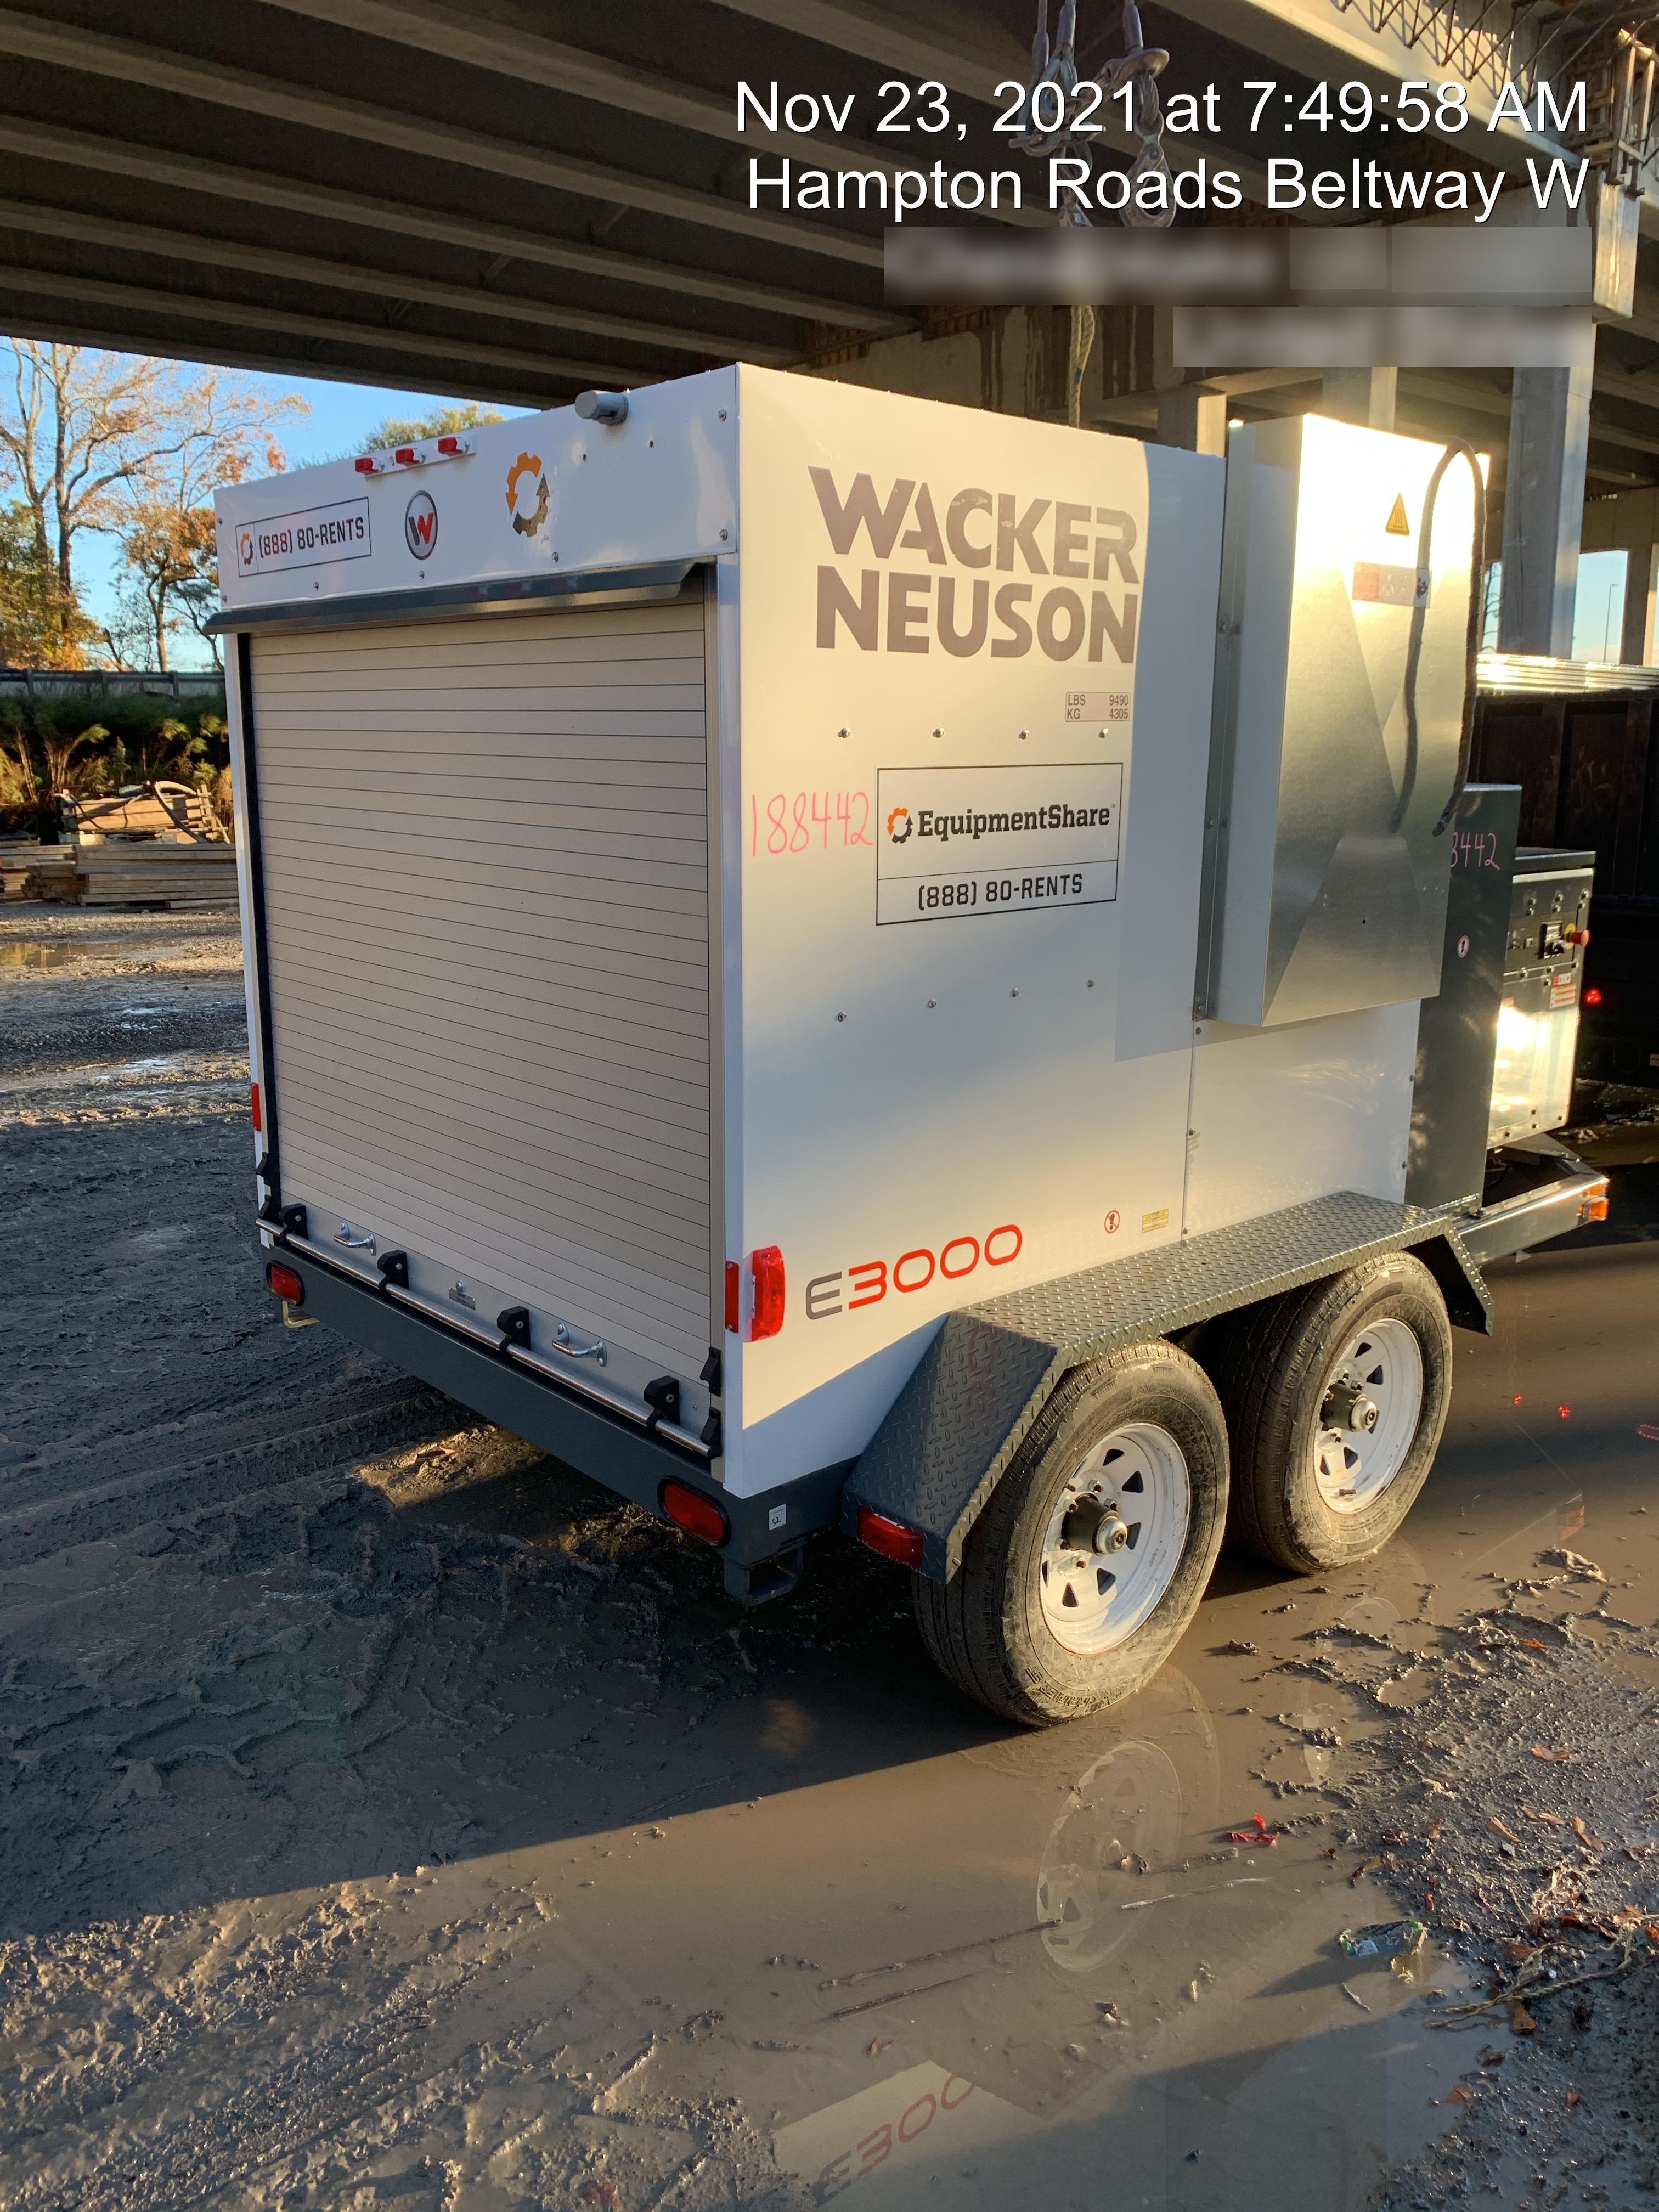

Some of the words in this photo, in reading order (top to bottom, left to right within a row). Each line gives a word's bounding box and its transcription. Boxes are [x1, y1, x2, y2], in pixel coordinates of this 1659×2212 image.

[259, 529, 293, 558] (888)
[297, 516, 364, 549] 80-RENTS
[808, 465, 1140, 584] WACKER
[816, 565, 1138, 664] NEUSON
[1066, 708, 1080, 720] KG
[1109, 708, 1129, 719] 4305
[1068, 694, 1086, 706] LBS
[1109, 695, 1129, 706] 9490
[751, 791, 874, 857] 188442
[918, 804, 1110, 842] EquipmentShare
[918, 881, 977, 911] (888)
[985, 873, 1082, 902] 80-RENTS
[805, 1224, 1023, 1319] E3000
